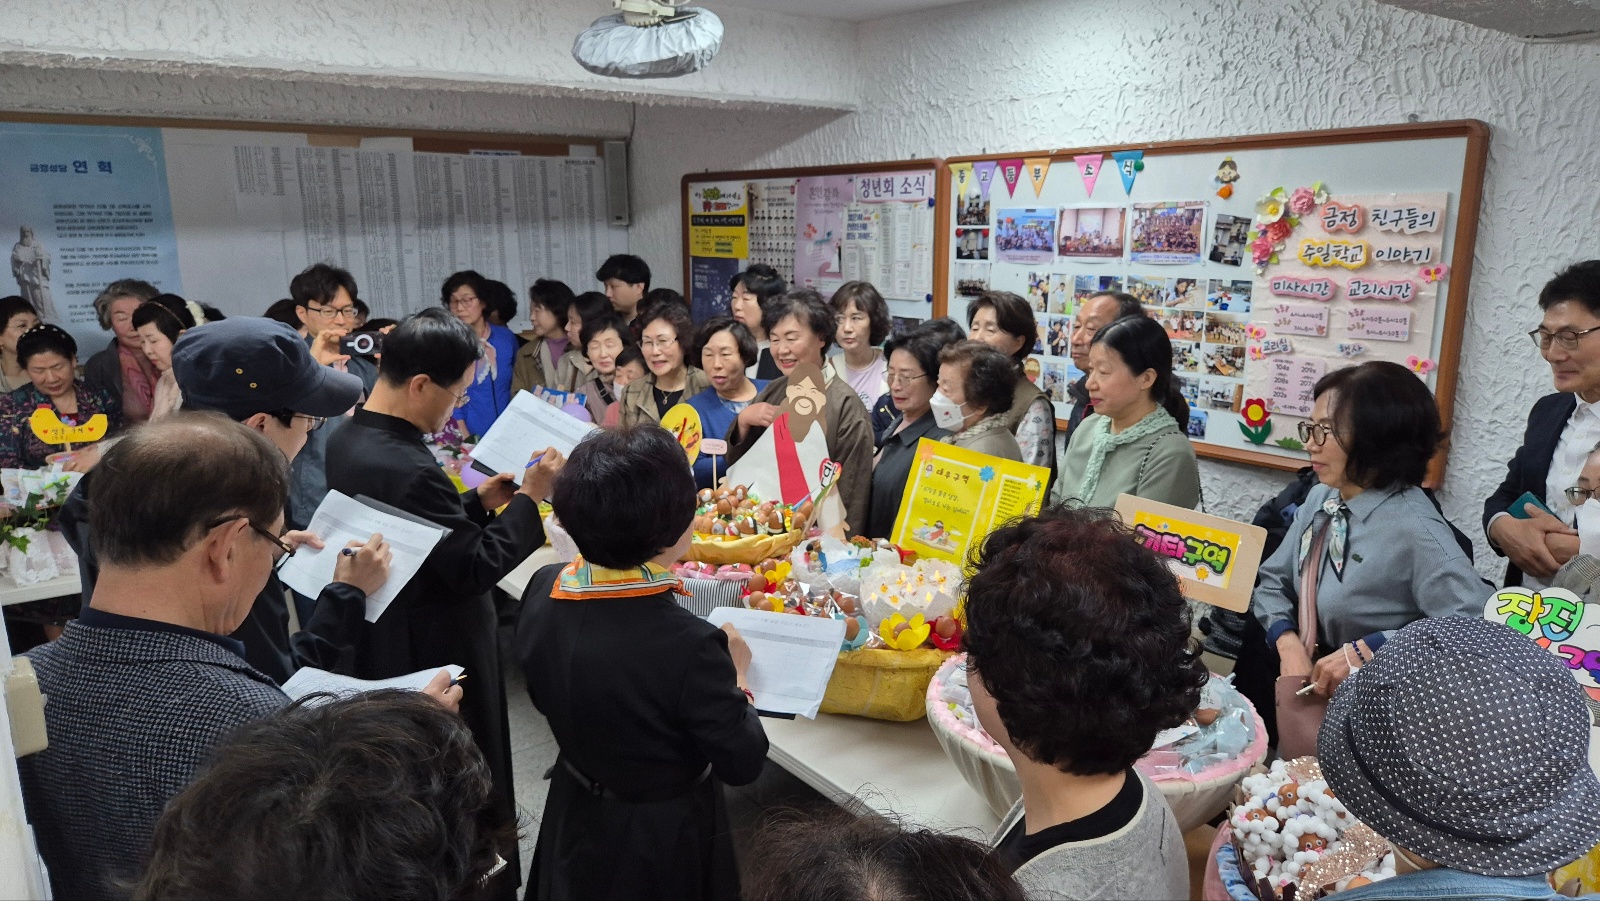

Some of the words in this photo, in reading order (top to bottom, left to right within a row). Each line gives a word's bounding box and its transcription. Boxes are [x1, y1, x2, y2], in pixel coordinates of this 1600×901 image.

[30, 163, 67, 173] 금정성당
[860, 177, 894, 198] 청년회
[900, 175, 926, 196] 소식
[1323, 207, 1357, 229] 금정
[1371, 208, 1436, 229] 친구들의
[1302, 243, 1363, 264] 주일학교
[1375, 246, 1430, 263] 이야기
[1273, 280, 1331, 297] 미사시간
[1348, 281, 1411, 300] 교리시간
[1263, 338, 1288, 352] 교리실
[1339, 343, 1363, 356] 행사
[1496, 592, 1585, 642] 장전
